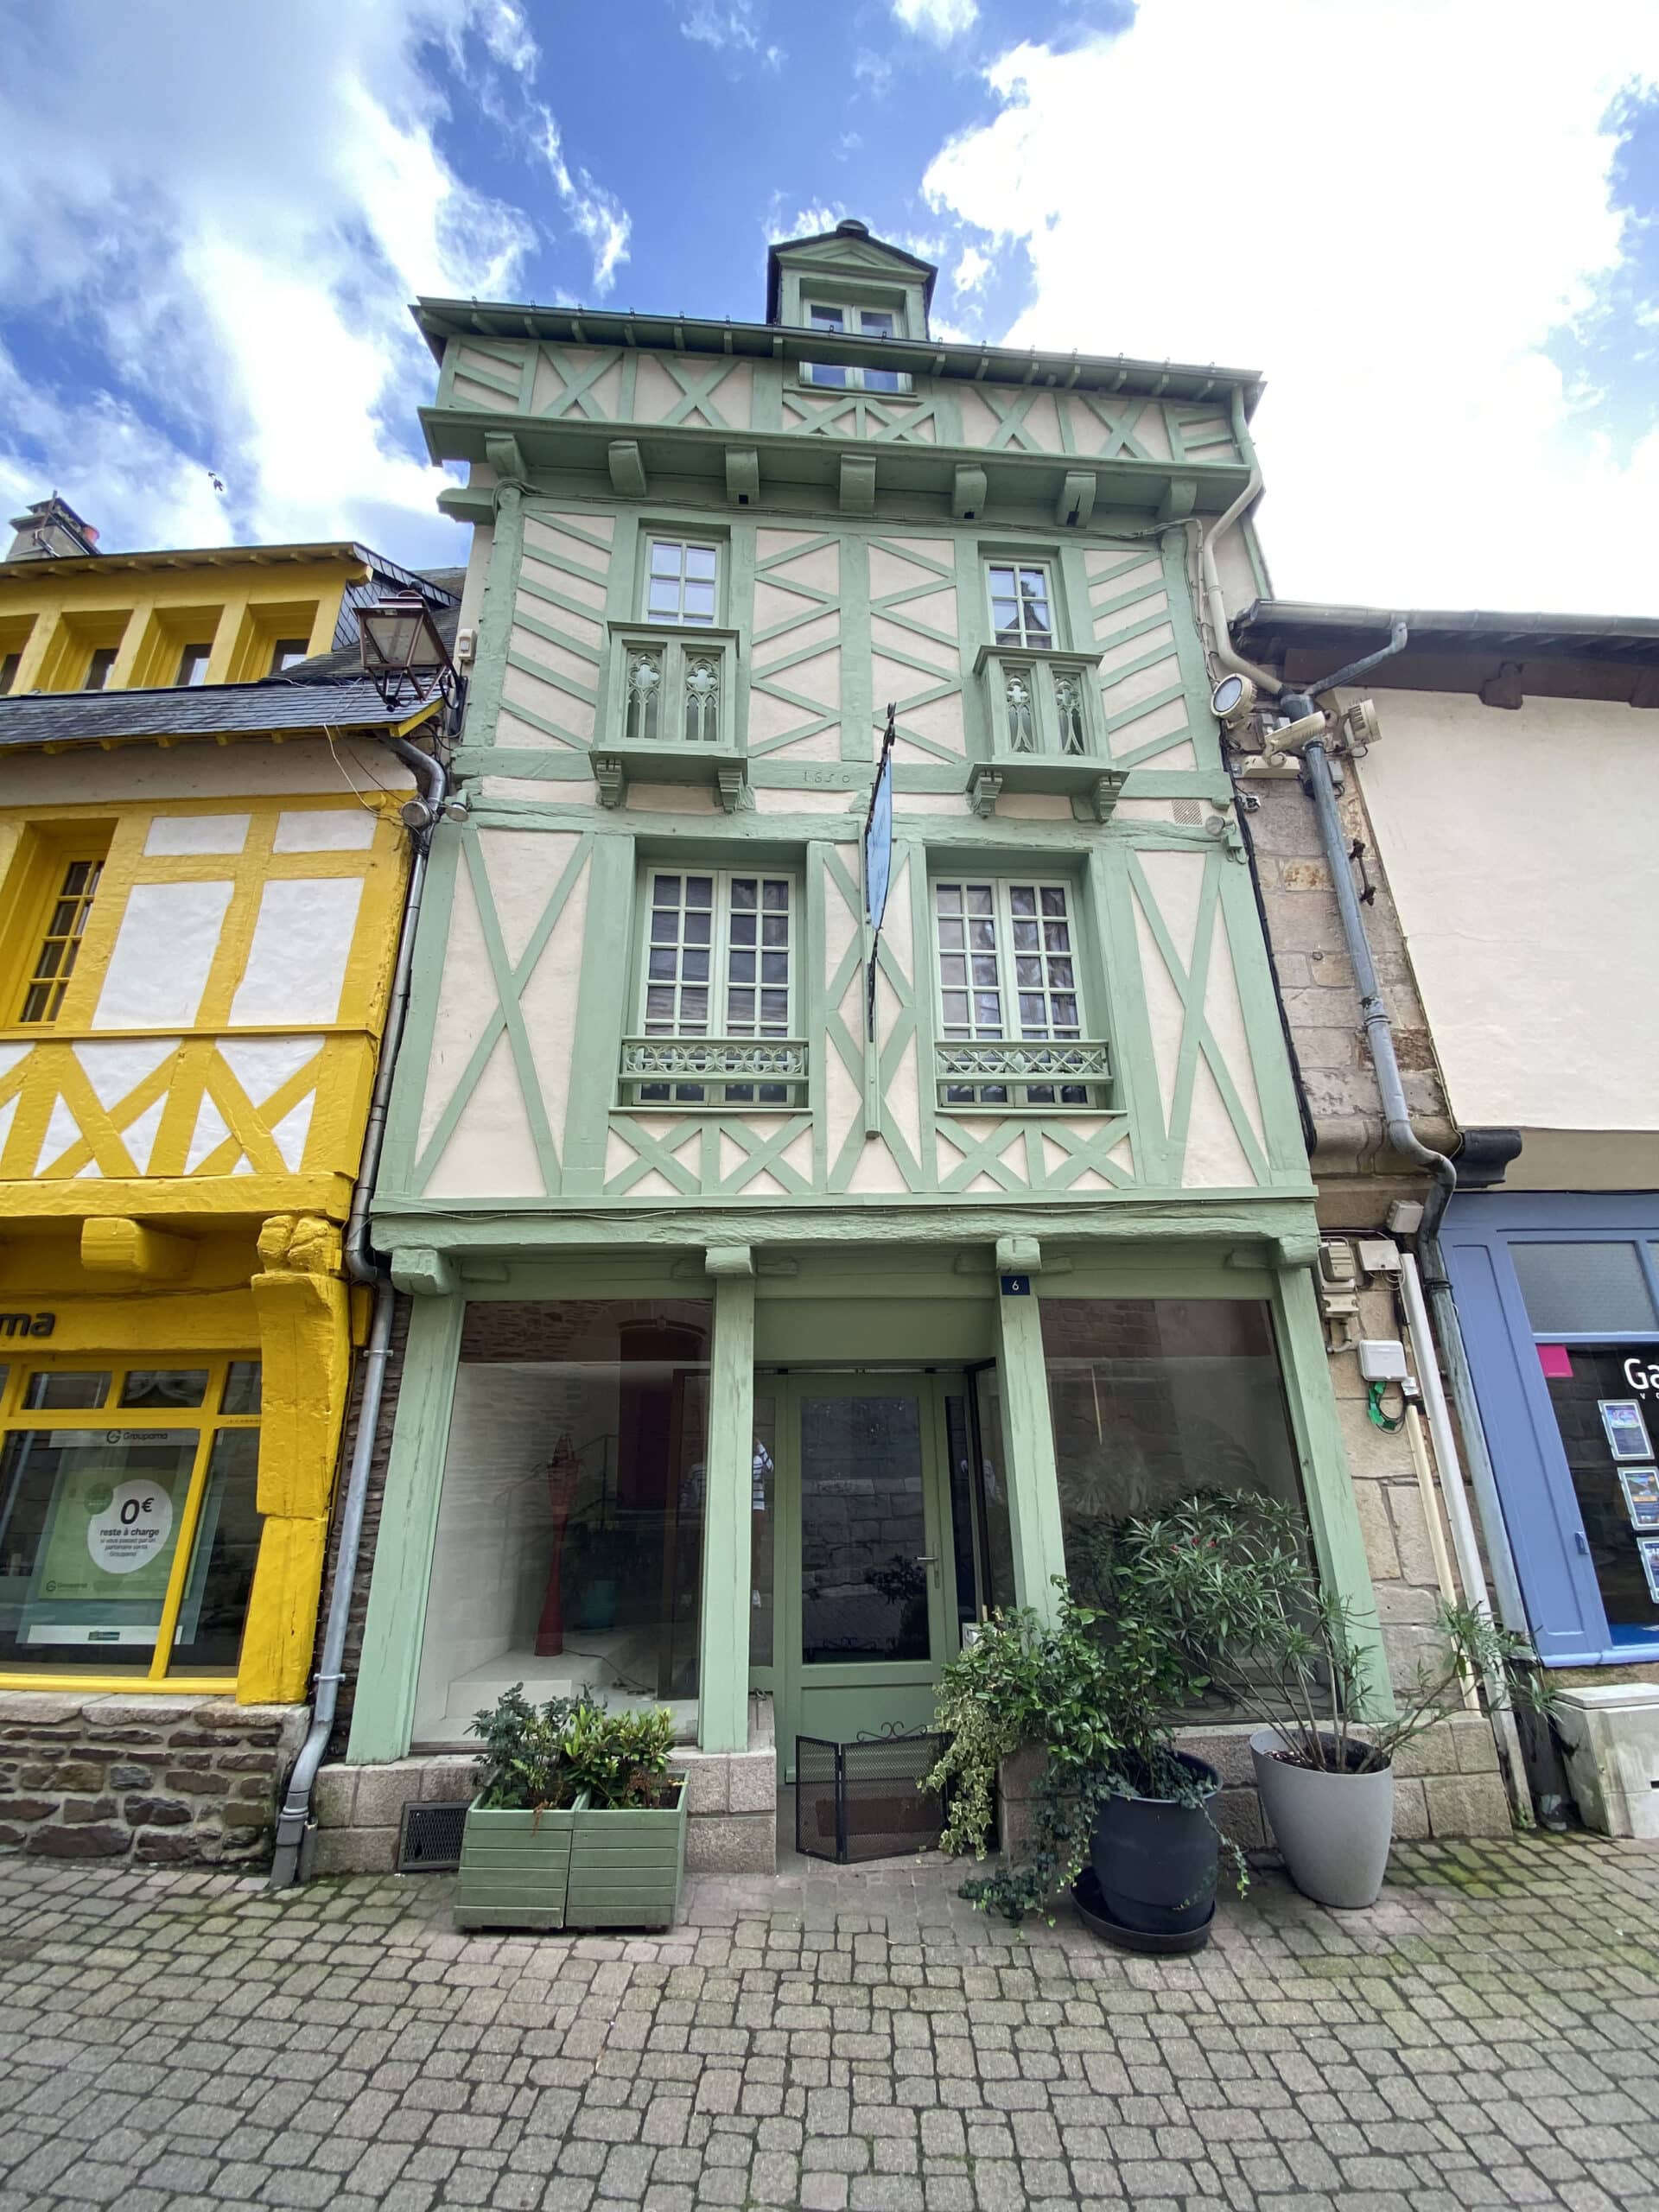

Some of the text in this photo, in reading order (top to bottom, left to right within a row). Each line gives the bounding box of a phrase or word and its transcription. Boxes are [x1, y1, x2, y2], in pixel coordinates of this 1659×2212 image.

[1012, 1280, 1020, 1291] 6
[0, 1313, 55, 1337] ma
[1624, 1357, 1659, 1389] Ga
[124, 1528, 129, 1536] à
[130, 1528, 160, 1538] charge
